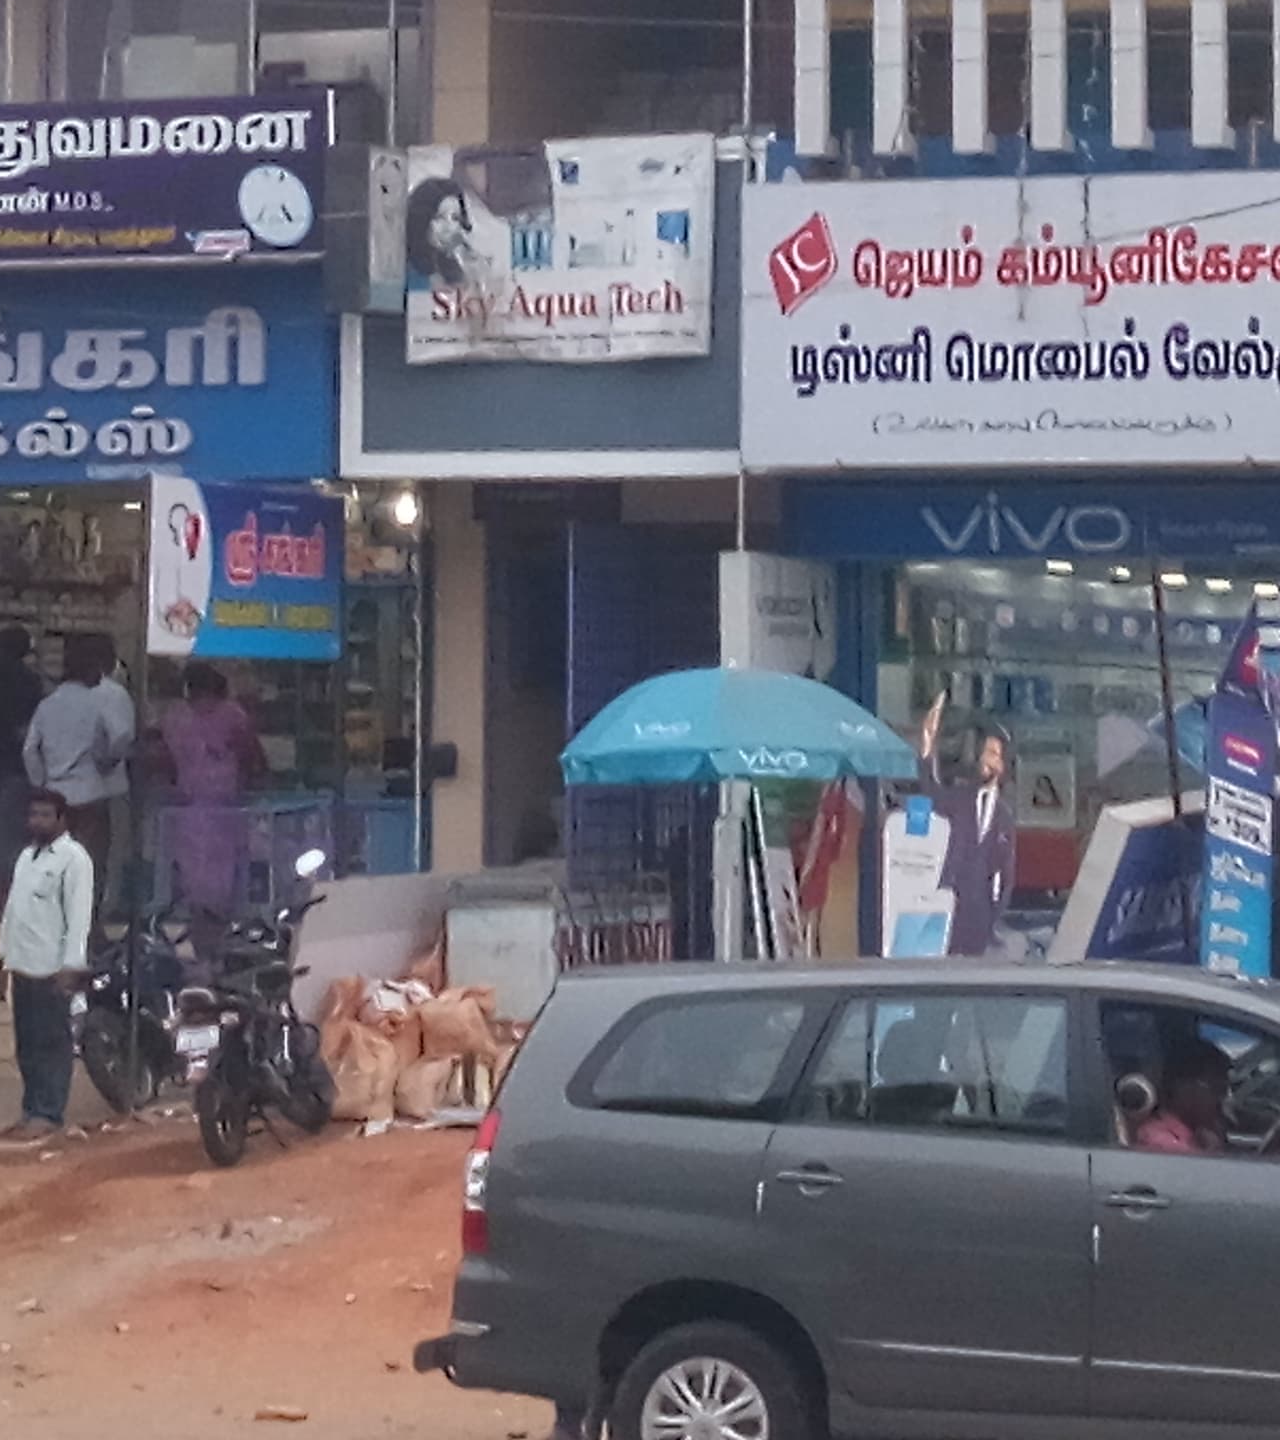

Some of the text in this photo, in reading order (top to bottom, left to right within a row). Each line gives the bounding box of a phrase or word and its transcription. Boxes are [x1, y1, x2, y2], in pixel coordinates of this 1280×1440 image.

[852, 223, 984, 300] ஜெயம்
[507, 282, 599, 328] Aqua
[608, 279, 685, 317] Tech
[790, 322, 933, 399] டிஸ்னி
[945, 316, 1151, 383] மொபைல்
[921, 489, 1134, 554] vivo
[738, 746, 810, 772] vivo
